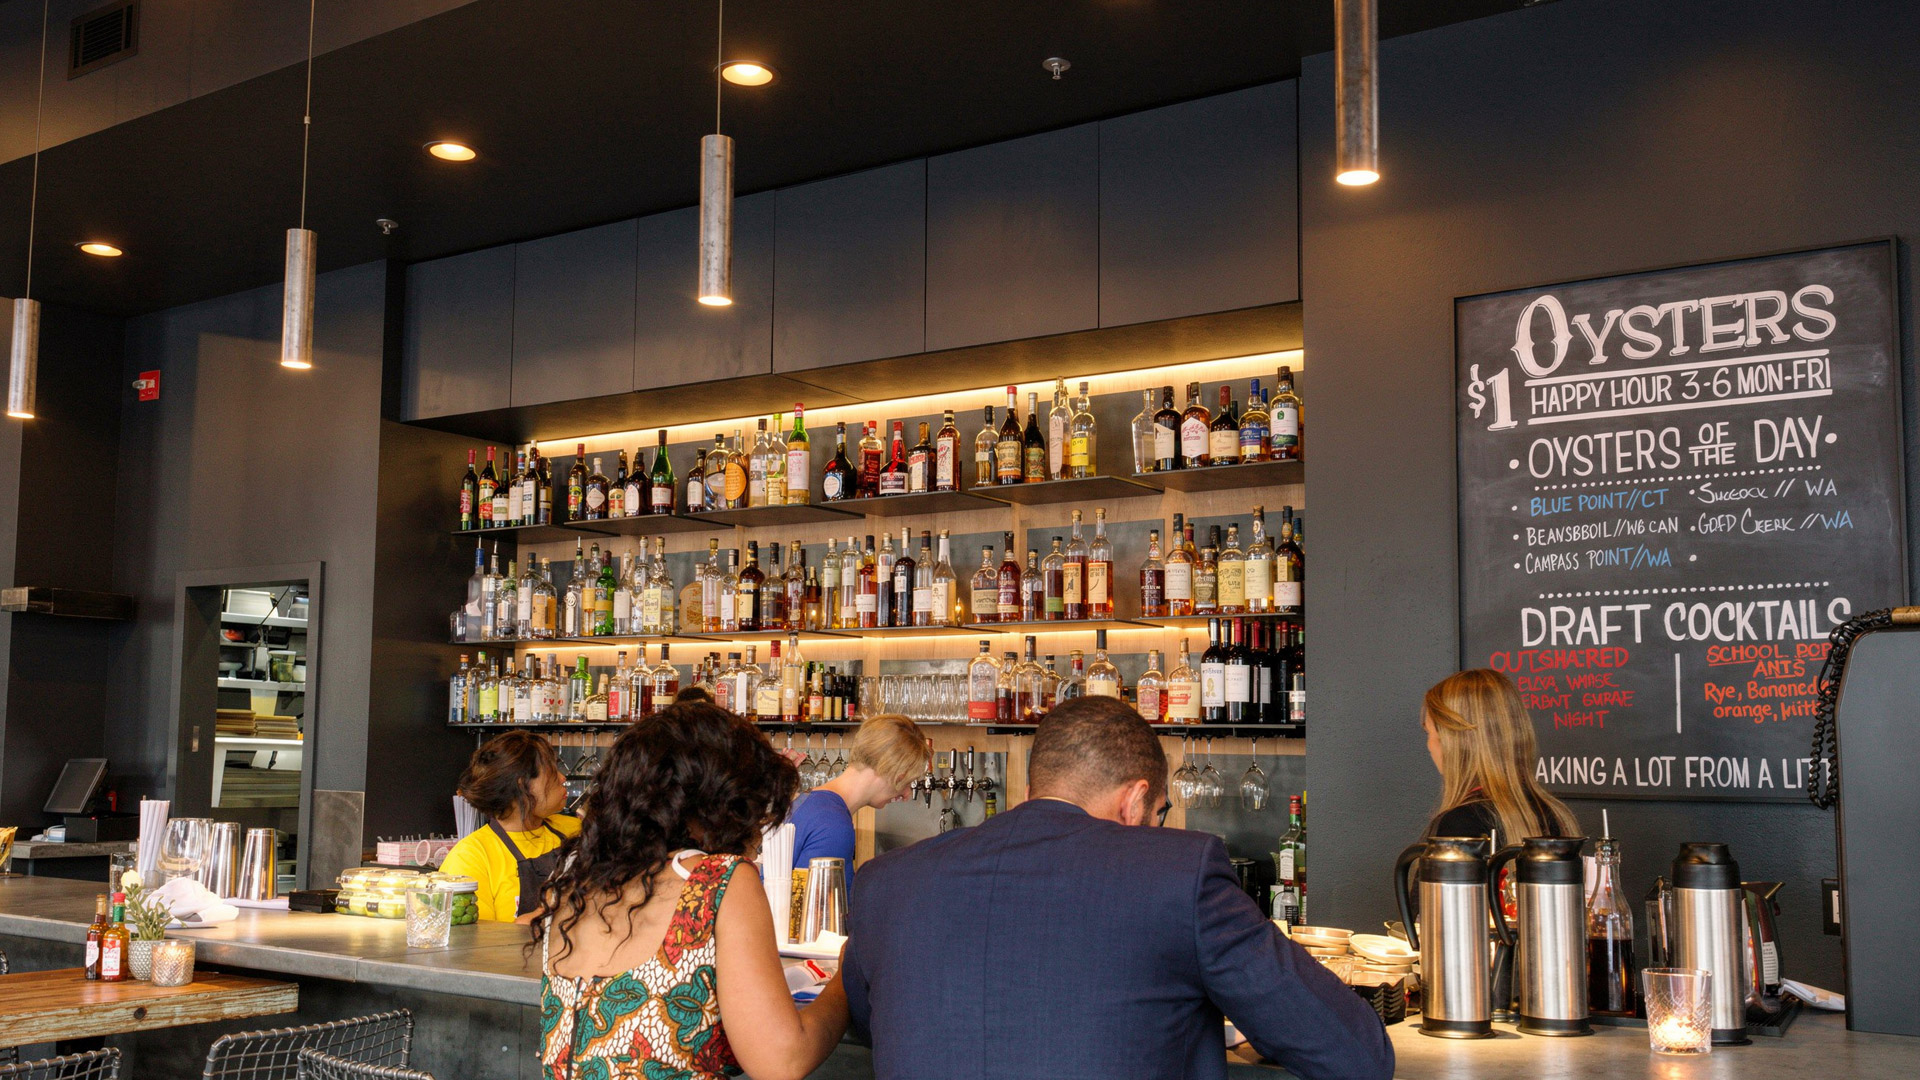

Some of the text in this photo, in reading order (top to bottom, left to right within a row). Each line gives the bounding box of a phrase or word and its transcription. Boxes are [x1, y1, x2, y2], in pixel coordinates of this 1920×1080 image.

[1510, 284, 1837, 377] OYSTERS
[1467, 363, 1519, 431] $1
[1530, 357, 1832, 415] HAPPY HOUR 3-6 MON-FRI
[1529, 415, 1823, 478] OYSTERS OF THE DAY
[1805, 478, 1838, 496] WA
[1530, 496, 1573, 517] BLUE
[1649, 516, 1679, 535] CAN
[1521, 597, 1851, 647] DRAFT COCKTAILS
[1706, 644, 1780, 664] SCHOOL
[1753, 658, 1806, 679] ANTS
[1704, 682, 1743, 705] Rye,
[1553, 710, 1610, 731] NIGHT
[1713, 703, 1778, 725] orange,
[1535, 756, 1607, 786] AKING
[1613, 757, 1628, 786] A
[1635, 756, 1676, 787] LOT
[1685, 756, 1751, 789] FROM
[1758, 758, 1775, 789] A
